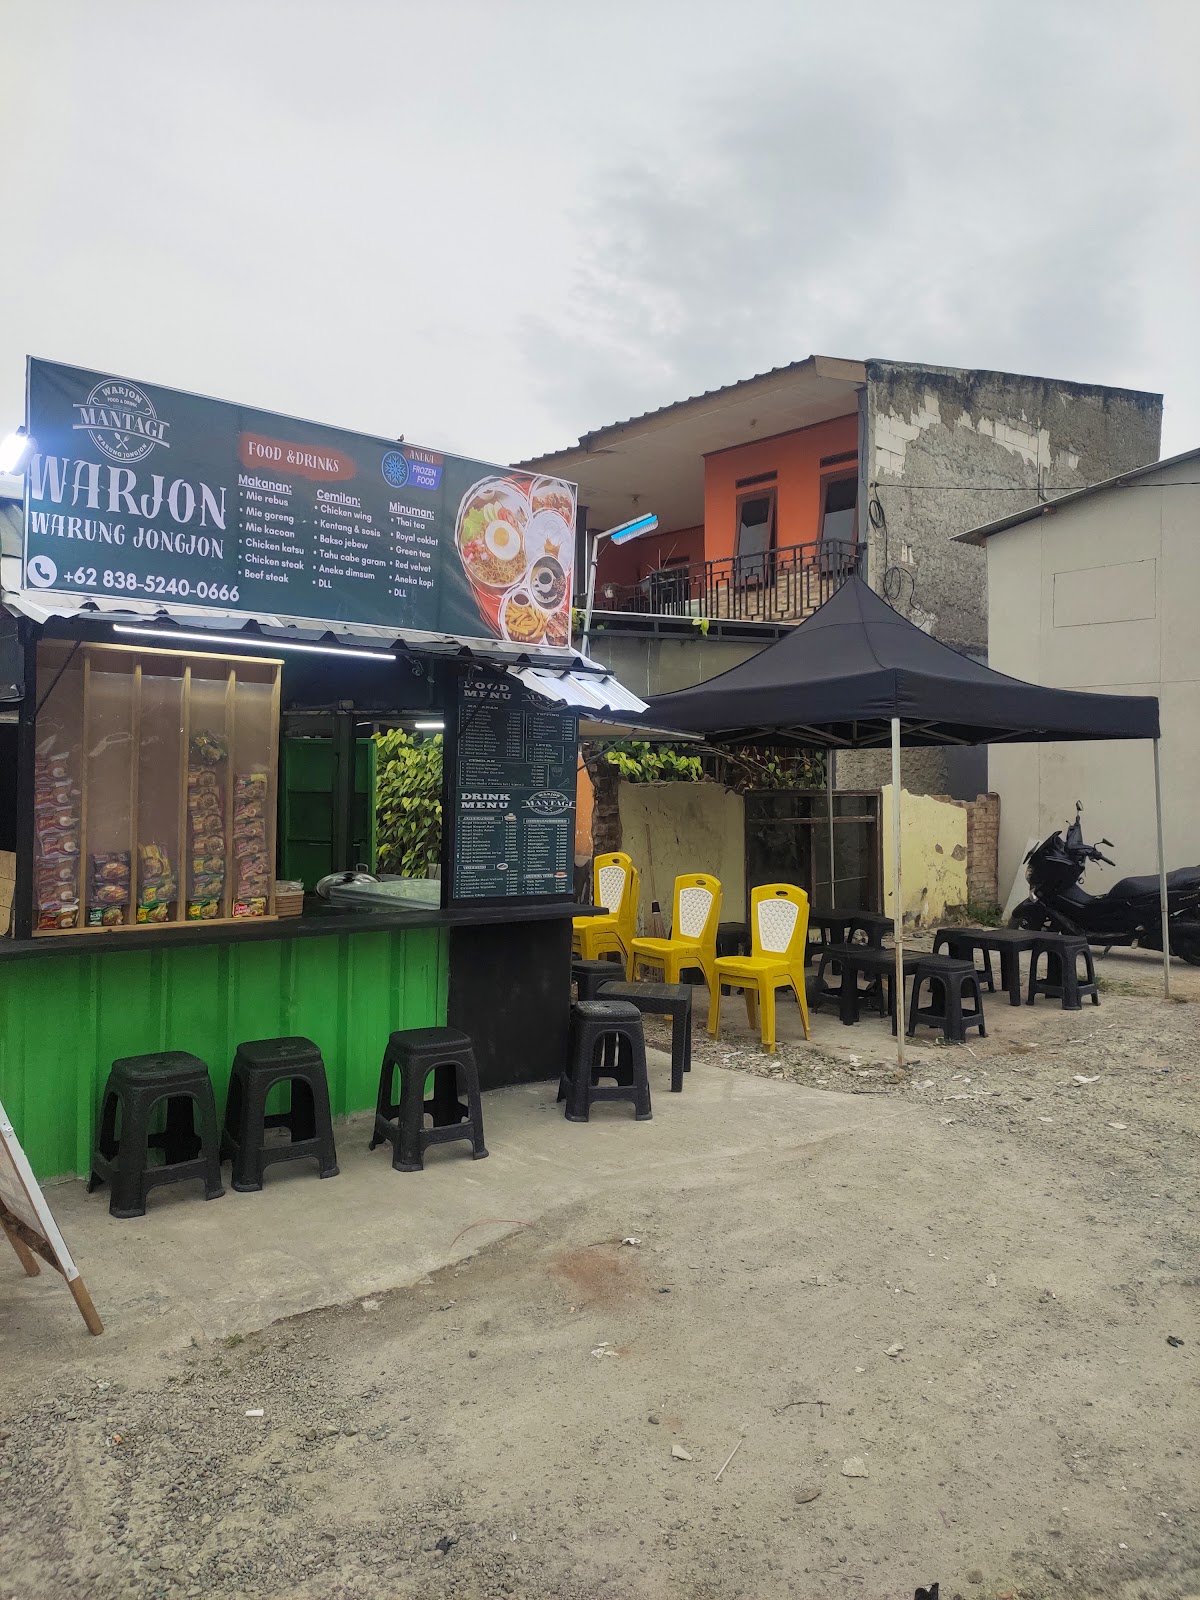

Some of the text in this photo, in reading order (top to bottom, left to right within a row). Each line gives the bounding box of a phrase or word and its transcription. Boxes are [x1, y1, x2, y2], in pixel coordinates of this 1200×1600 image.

[102, 386, 143, 404] WARJON
[80, 407, 165, 440] MANTAGI
[97, 434, 148, 458] WARUNG JONGJON
[248, 441, 282, 461] FOOD
[412, 465, 437, 477] FROZEN
[238, 473, 292, 494] Makanan:
[416, 475, 435, 486] FOOD
[30, 453, 227, 530] WARJON
[246, 491, 289, 507] Mie rebus
[316, 488, 361, 506] Cemilan:
[245, 507, 294, 525] Mie goreng
[320, 504, 372, 523] Chicken wing
[389, 501, 434, 519] Minuman:
[245, 523, 295, 538] Mie kacoan
[320, 519, 381, 538] Kentang & sosis
[396, 517, 425, 530] Thai tea
[31, 511, 224, 559] WARUNG JONGJON
[319, 534, 369, 550] Bakso jebew
[396, 531, 439, 547] Royal coklat
[245, 538, 304, 555] Chicken katsu
[396, 546, 431, 559] Green tea
[245, 554, 304, 570] Chicken steak
[319, 549, 386, 568] Tahu cabe garam
[395, 560, 431, 573] Red velvet
[244, 569, 289, 584] Beef steak
[319, 564, 375, 580] Aneka dimsum
[64, 567, 240, 602] +62 838-5240-0666
[318, 579, 332, 588] DLL
[394, 574, 434, 588] Aneka kopi
[394, 588, 407, 598] DLL
[463, 690, 512, 700] MENU
[461, 793, 511, 801] DRINK
